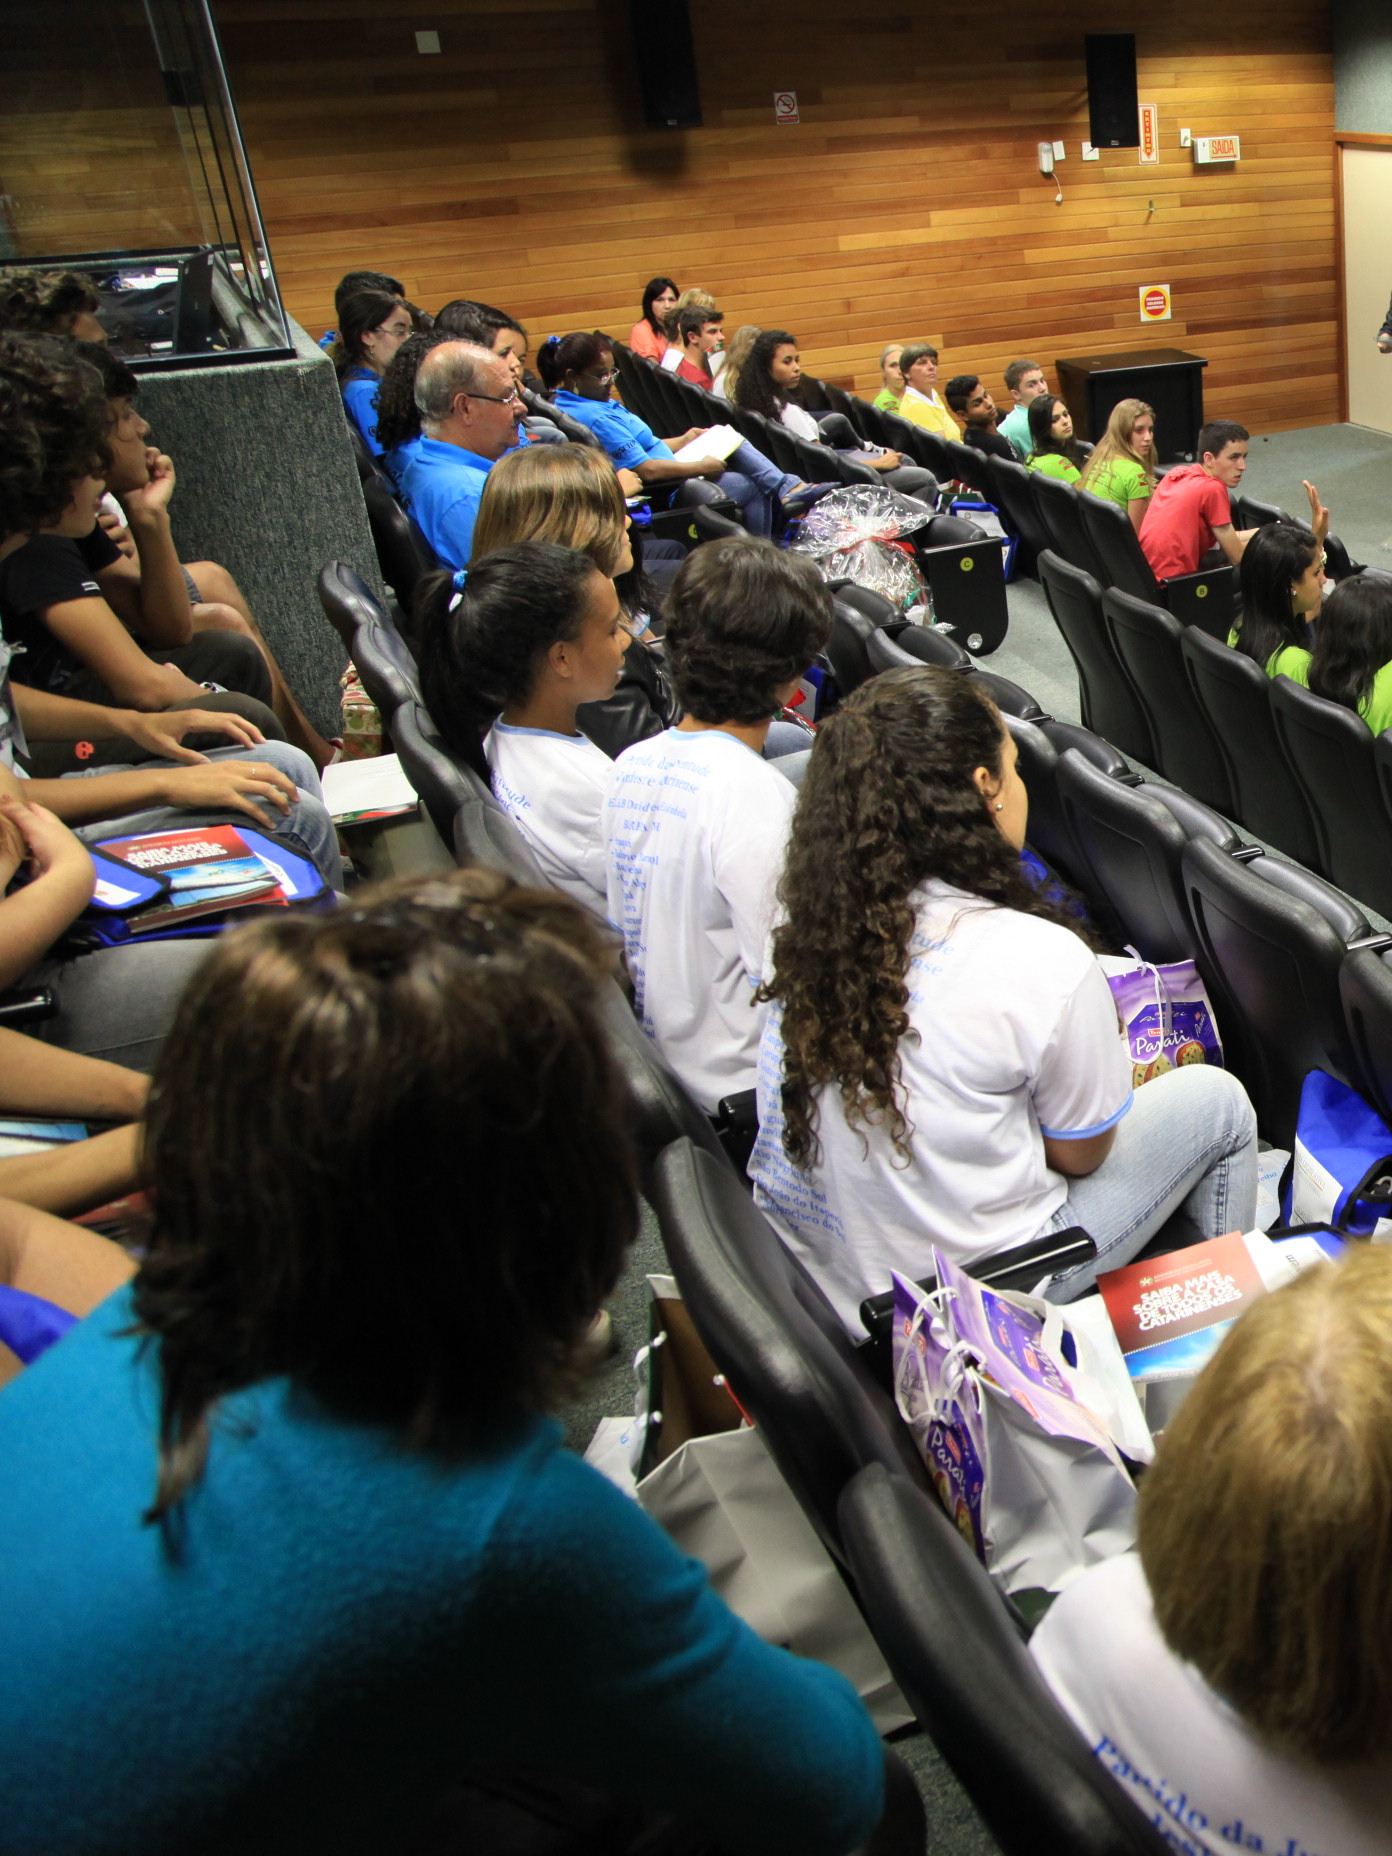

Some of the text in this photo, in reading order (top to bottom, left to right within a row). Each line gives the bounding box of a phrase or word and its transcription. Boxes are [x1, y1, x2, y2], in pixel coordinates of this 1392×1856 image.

[1136, 1030, 1190, 1055] Parati
[1132, 1275, 1235, 1315] SOBRE A CASA
[1139, 1284, 1236, 1323] DE TODOS OS
[1140, 1270, 1222, 1303] SAIBA MAIS
[1138, 1289, 1243, 1331] CATARINENSES
[1221, 1820, 1264, 1853] da
